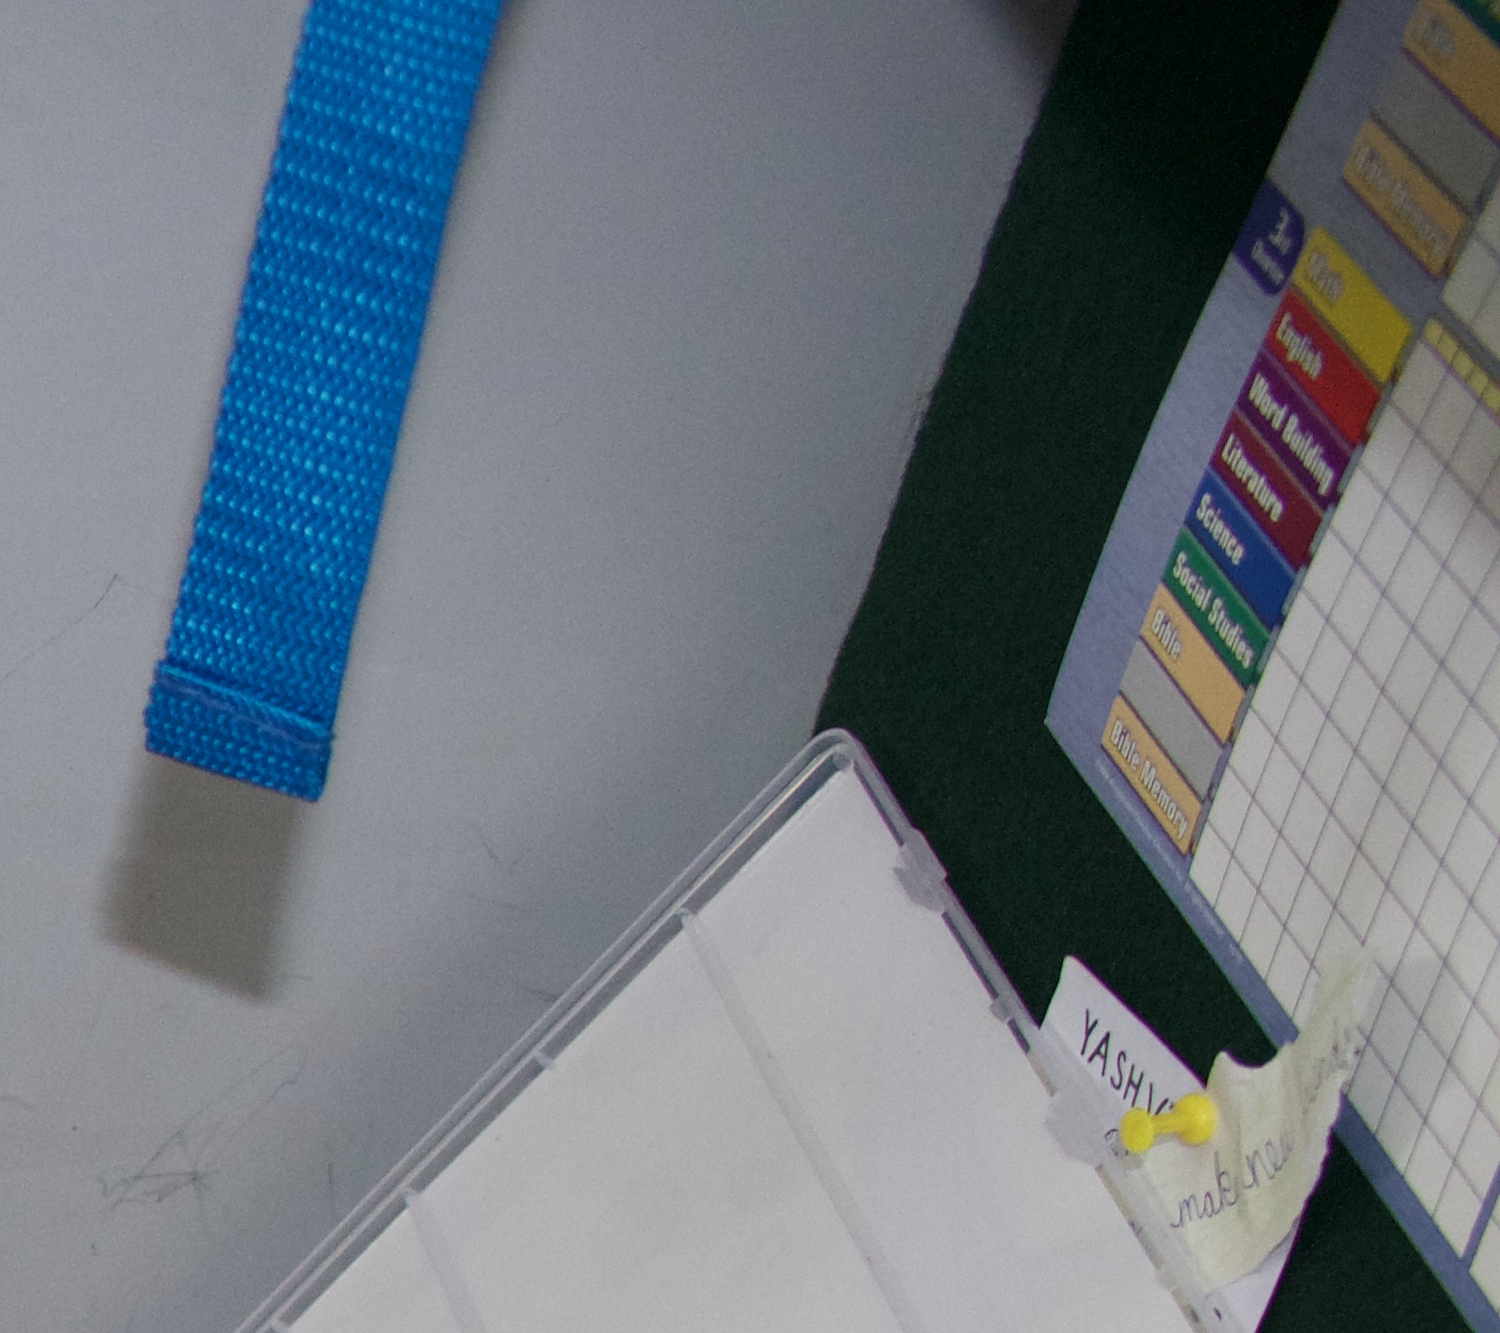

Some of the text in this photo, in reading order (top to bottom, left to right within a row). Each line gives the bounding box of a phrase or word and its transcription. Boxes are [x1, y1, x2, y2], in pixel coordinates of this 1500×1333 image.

[1275, 312, 1323, 380] English
[1221, 434, 1284, 522] Literature
[1249, 372, 1336, 496] Word Building
[1195, 492, 1246, 566] Science
[1151, 607, 1183, 660] Bible
[1172, 551, 1254, 669] Social Studies
[1110, 719, 1190, 840] Bible Memory
